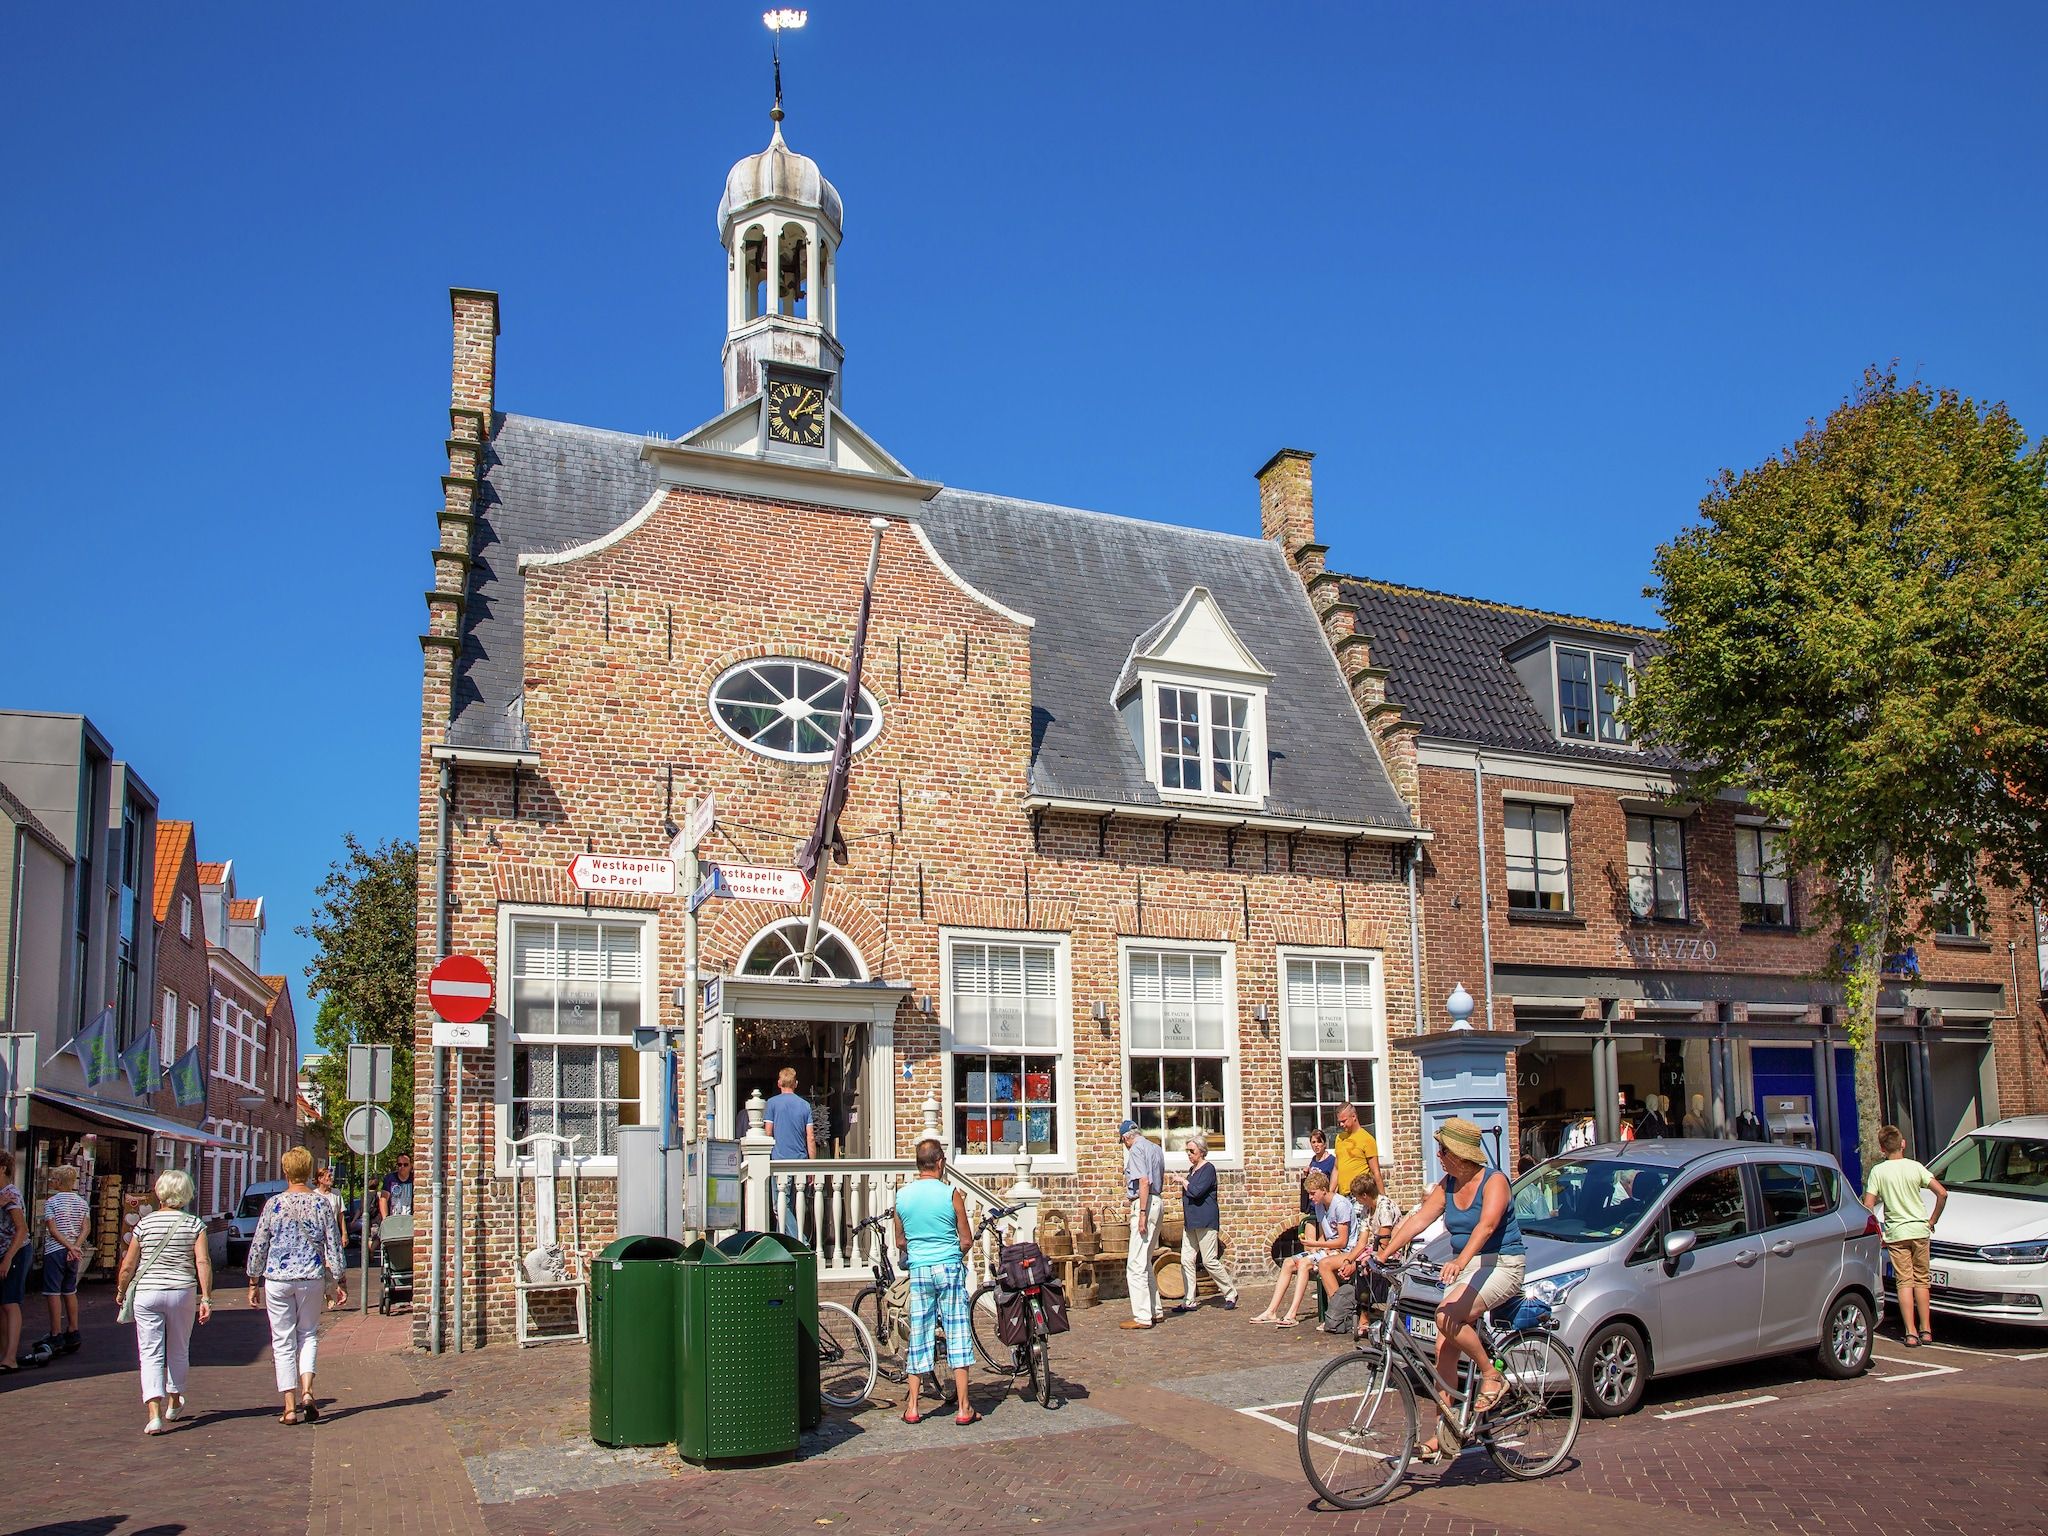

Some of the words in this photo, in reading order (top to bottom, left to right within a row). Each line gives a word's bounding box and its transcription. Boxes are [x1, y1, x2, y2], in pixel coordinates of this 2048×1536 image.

[593, 860, 666, 873] Westkapelle
[592, 874, 606, 883] De
[610, 875, 642, 885] Parel
[721, 869, 783, 882] ostkapelle
[720, 883, 785, 896] erooskerke
[1614, 934, 1717, 960] PALAZZO
[571, 1004, 584, 1018] &
[1000, 1019, 1010, 1031] &
[1172, 1023, 1182, 1034] &
[1326, 1027, 1335, 1038] &
